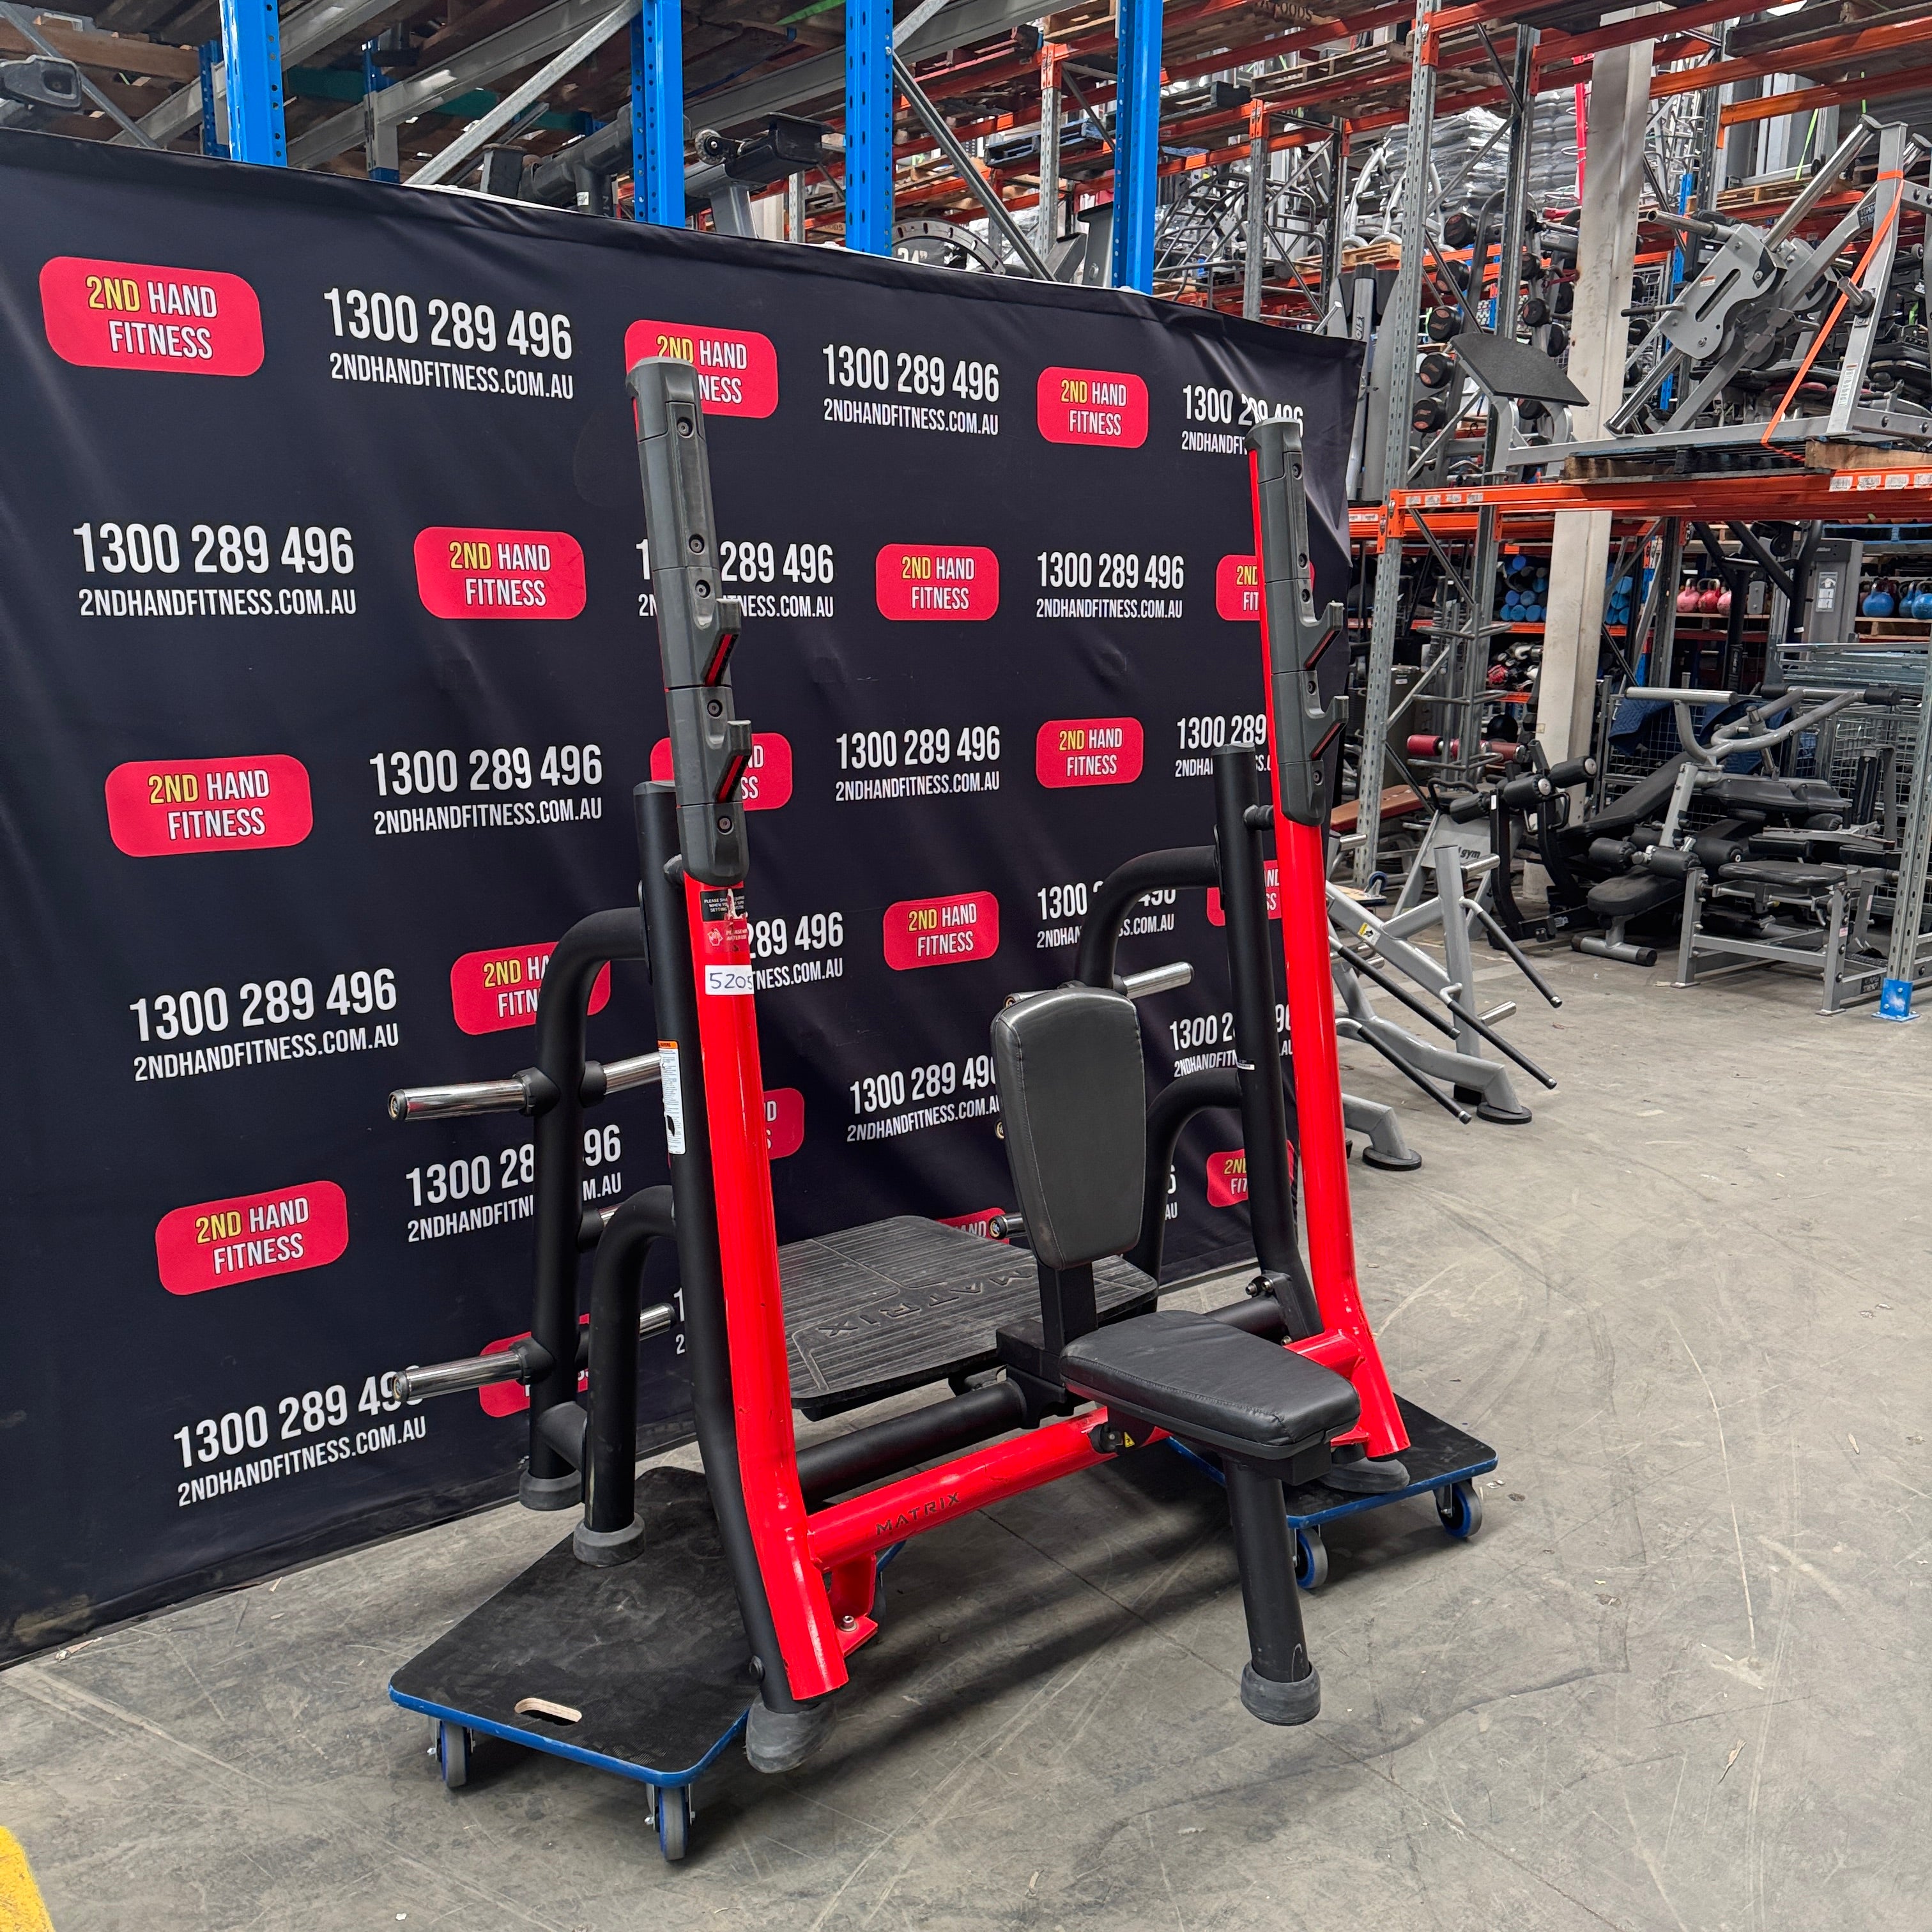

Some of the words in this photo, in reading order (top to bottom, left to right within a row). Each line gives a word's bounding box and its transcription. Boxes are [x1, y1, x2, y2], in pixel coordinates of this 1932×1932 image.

[86, 276, 140, 311] 2ND
[147, 281, 217, 318] HAND
[109, 320, 213, 359] FITNESS
[323, 288, 418, 344] 1300
[428, 299, 496, 352] 289
[507, 309, 572, 360] 496
[657, 335, 694, 364] 2ND
[699, 339, 747, 369] HAND
[330, 352, 574, 399] 2NDHANDFITNESS.COM.AU
[698, 374, 742, 404] NESS
[822, 344, 889, 390] 1300
[896, 352, 945, 397] 289
[952, 360, 999, 402] 496
[1061, 379, 1087, 403] 2ND
[1092, 381, 1126, 406] HAND
[1183, 384, 1234, 424] 1300
[824, 397, 999, 436] 2NDHANDFITNESS.COM.AU
[1070, 410, 1121, 436] FITNESS
[73, 523, 180, 574] 1300
[191, 524, 269, 574] 289
[280, 526, 354, 574] 496
[449, 542, 491, 569] 2ND
[497, 543, 551, 571] HAND
[720, 540, 775, 583] 289
[783, 543, 834, 584] 496
[902, 556, 931, 579] 2ND
[936, 557, 974, 580] HAND
[1037, 551, 1092, 588] 1300
[1098, 553, 1139, 588] 289
[1144, 555, 1184, 590] 496
[79, 588, 356, 617] 2NDHANDFITNESS.COM.AU
[465, 578, 546, 606] FITNESS
[638, 594, 834, 618] 2NNESS.COM.AU
[912, 586, 969, 610] FITNESS
[1036, 598, 1183, 618] 2NDHANDFITNESS.COM.AU
[836, 730, 897, 769] 1300
[904, 728, 950, 765] 289
[956, 725, 1000, 762] 496
[1059, 730, 1085, 751] 2ND
[1089, 728, 1123, 749] HAND
[1177, 716, 1225, 749] 1300
[1230, 714, 1267, 746] 289
[369, 749, 458, 796] 1300
[469, 747, 532, 790] 289
[540, 744, 602, 786] 496
[1067, 754, 1117, 777] FITNESS
[148, 774, 198, 804] 2ND
[206, 770, 270, 801] HAND
[836, 770, 1000, 801] 2NDHANDFITNESS.COM.AU
[168, 807, 265, 839] FITNESS
[374, 797, 602, 835] 2NDHANDFITNESS.COM.AU
[908, 908, 937, 931] 2ND
[942, 903, 977, 927] HAND
[1037, 882, 1087, 920] 1300
[794, 912, 843, 951] 496
[917, 930, 974, 957] FITNESS
[1036, 913, 1175, 948] 2NDHANS.COM.AU
[484, 960, 521, 988] 2ND
[527, 954, 549, 981] HA
[709, 972, 753, 990] 5205
[753, 957, 843, 990] NESS.COM.AU
[129, 987, 229, 1041] 1300
[240, 977, 314, 1027] 289
[326, 968, 397, 1015] 496
[498, 988, 541, 1018] FITN
[1169, 1015, 1218, 1051] 1300
[134, 1023, 399, 1082] 2NDHANDFITNESS.COM.AU
[850, 1071, 905, 1114] 1300
[911, 1062, 956, 1101] 289
[406, 1155, 491, 1207] 1300
[500, 1143, 535, 1189] 28
[582, 1124, 622, 1167] 96
[195, 1211, 241, 1243] 2ND
[249, 1197, 309, 1232] HAND
[408, 1172, 622, 1243] 2NDHANDFITNM.AU
[213, 1232, 303, 1274] FITNESS
[173, 1406, 268, 1468] 1300
[279, 1384, 348, 1440] 289
[358, 1365, 424, 1416] 49
[178, 1415, 426, 1507] 2NDHANDFITNESS.COM.AU
[875, 1491, 960, 1536] MATRIX
